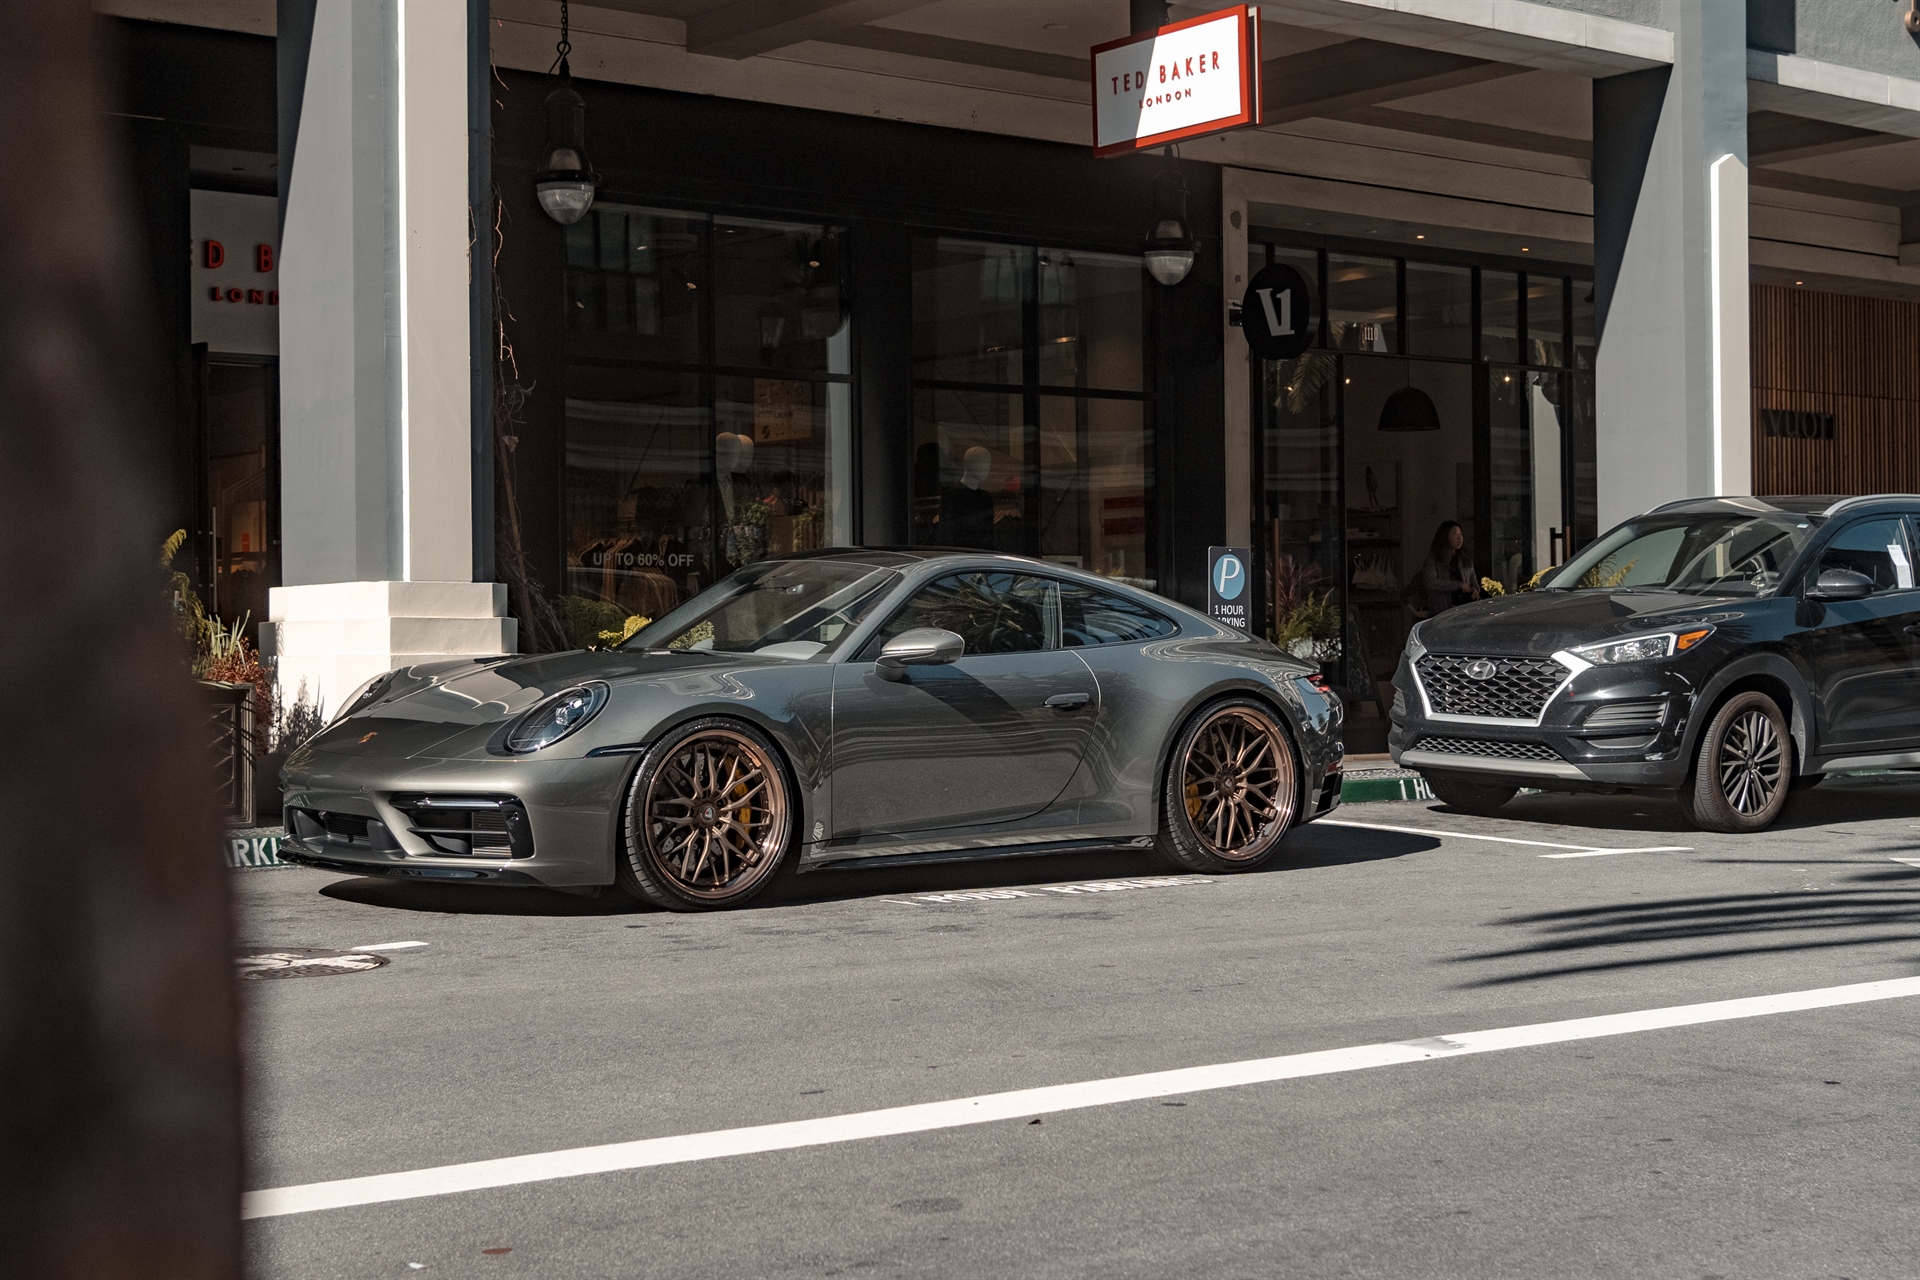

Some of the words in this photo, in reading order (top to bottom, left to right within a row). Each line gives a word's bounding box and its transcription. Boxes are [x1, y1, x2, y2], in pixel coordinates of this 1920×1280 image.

[1111, 71, 1144, 95] TED
[1159, 51, 1219, 84] BAKER
[1139, 88, 1191, 109] LONDON
[1364, 327, 1379, 340] 1110
[593, 552, 612, 565] UP
[616, 552, 634, 566] TO
[637, 553, 665, 567] 60%
[668, 554, 694, 567] OFF
[1219, 558, 1240, 593] P
[1214, 605, 1219, 615] 1
[1221, 605, 1244, 615] HOUR
[1217, 617, 1246, 628] KING
[1399, 779, 1407, 800] 1
